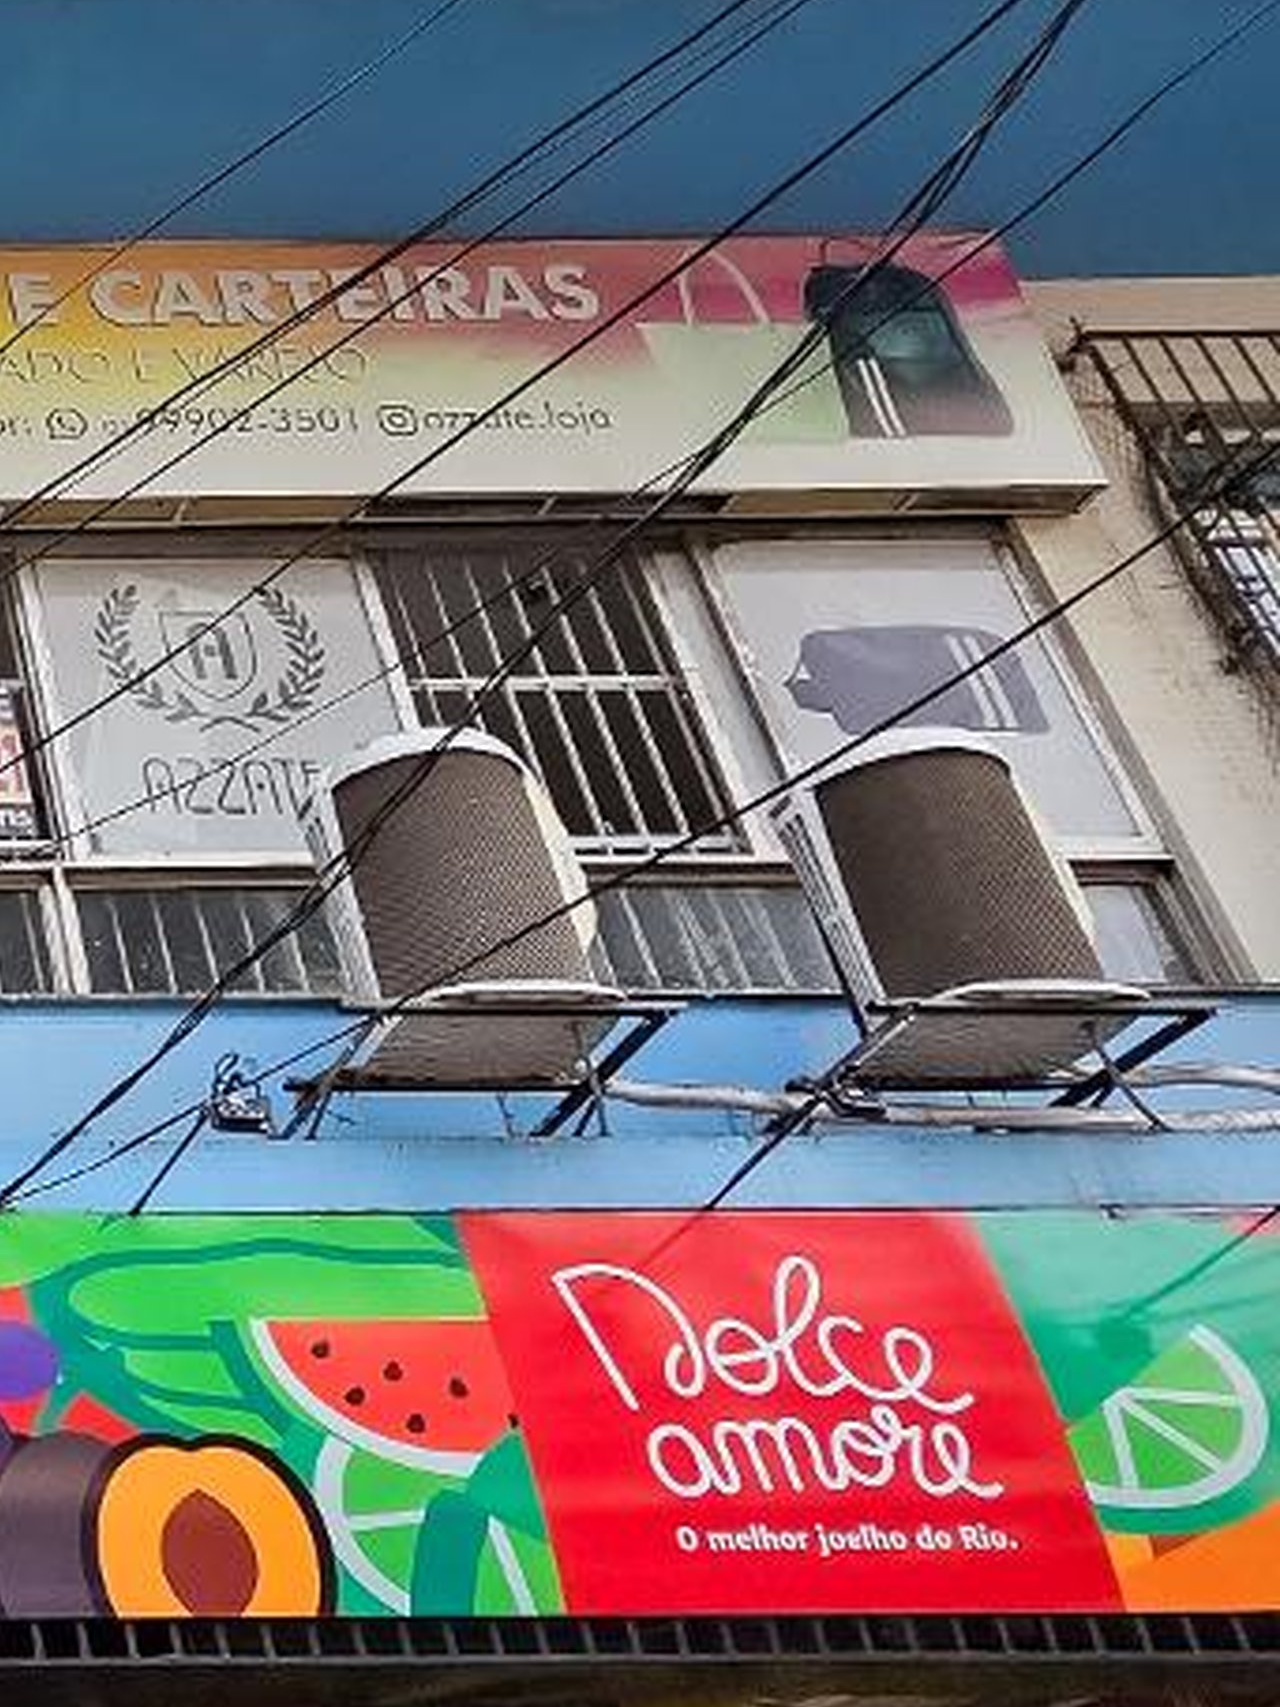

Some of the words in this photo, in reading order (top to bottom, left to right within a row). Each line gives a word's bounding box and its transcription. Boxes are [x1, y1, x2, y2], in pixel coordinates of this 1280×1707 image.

[9, 272, 52, 326] E
[87, 263, 601, 327] CARTEIRAS
[551, 1253, 976, 1414] Dolce
[647, 1404, 1005, 1500] amore
[675, 1524, 701, 1552] O
[706, 1522, 809, 1551] melhor
[813, 1522, 909, 1558] joelho
[915, 1522, 954, 1551] do
[957, 1522, 1021, 1551] Rio.
